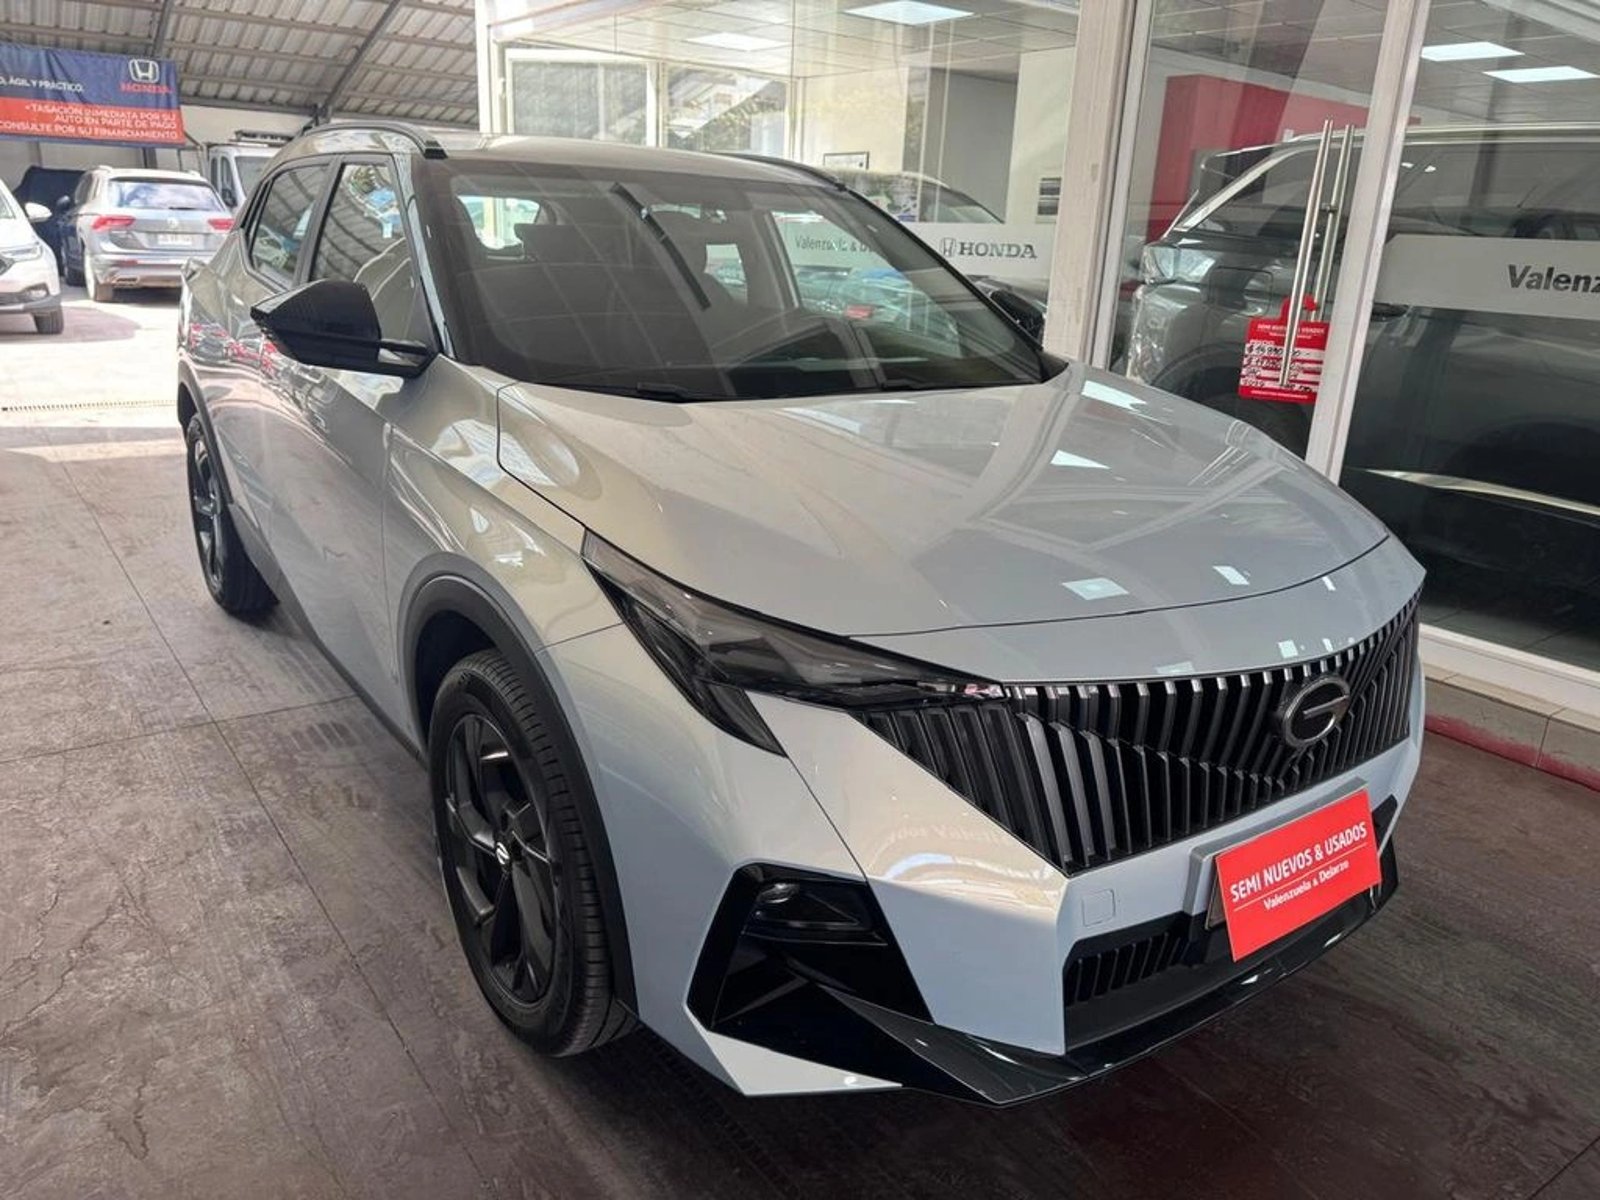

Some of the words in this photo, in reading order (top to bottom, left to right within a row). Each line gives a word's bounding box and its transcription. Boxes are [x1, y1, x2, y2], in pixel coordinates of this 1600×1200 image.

[54, 114, 83, 124] AUTO
[102, 118, 133, 128] PARTE
[135, 120, 146, 128] DE
[150, 121, 177, 130] PAGO
[140, 112, 160, 121] POR
[161, 113, 176, 121] SU
[54, 124, 75, 133] POR
[79, 127, 93, 135] SU
[959, 241, 1037, 259] HONDA
[1230, 870, 1261, 902] SEMI
[1264, 849, 1313, 886] NUEVOS
[1314, 844, 1324, 860] &
[1325, 822, 1367, 854] USADOS
[1263, 880, 1312, 910] Valenzuela
